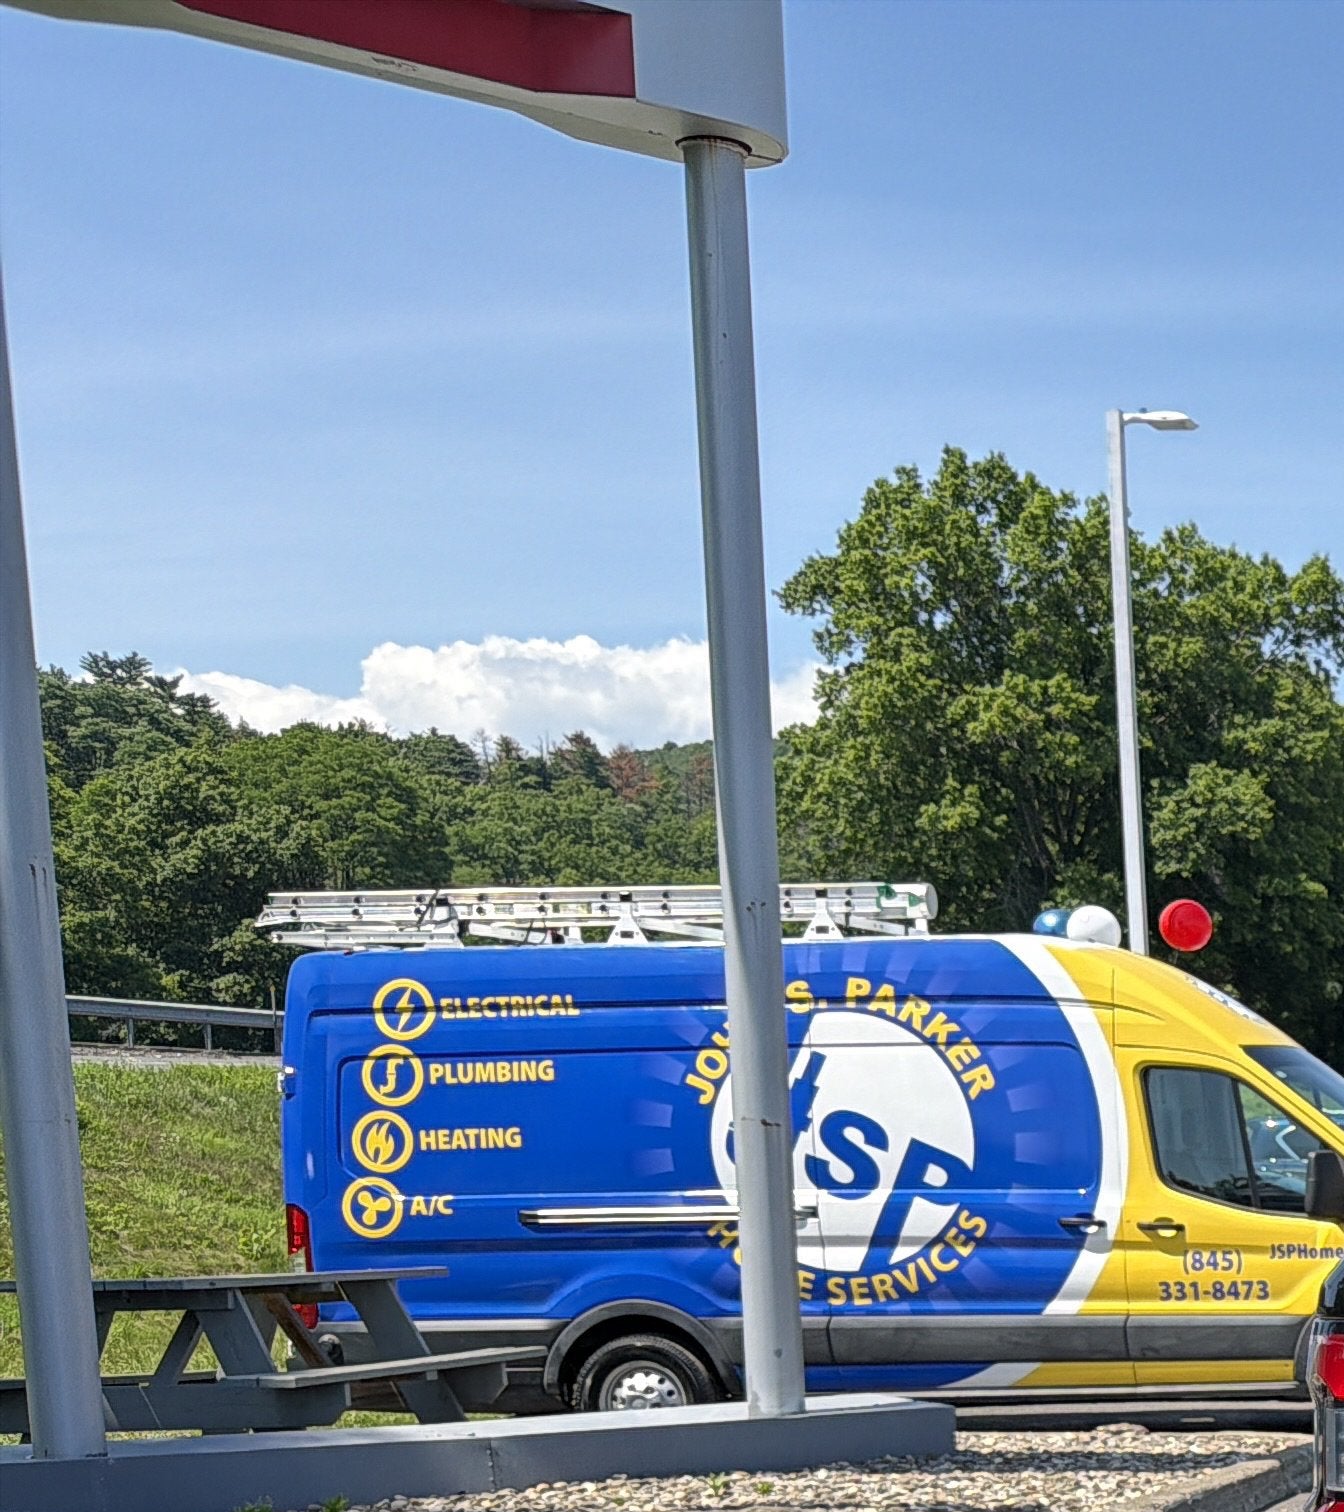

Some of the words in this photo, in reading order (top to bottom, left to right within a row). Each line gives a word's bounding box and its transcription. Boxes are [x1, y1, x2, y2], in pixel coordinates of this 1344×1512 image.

[440, 995, 580, 1019] ELECTRICAL
[686, 1021, 730, 1105] JO
[845, 976, 996, 1100] PARKER
[430, 1061, 555, 1085] PLUMBING
[420, 1127, 522, 1151] HEATING
[411, 1194, 454, 1216] A/C
[707, 1221, 816, 1300] HE
[827, 1210, 988, 1306] SERVICES
[1183, 1248, 1243, 1275] (845)
[1159, 1280, 1270, 1302] 331-8473
